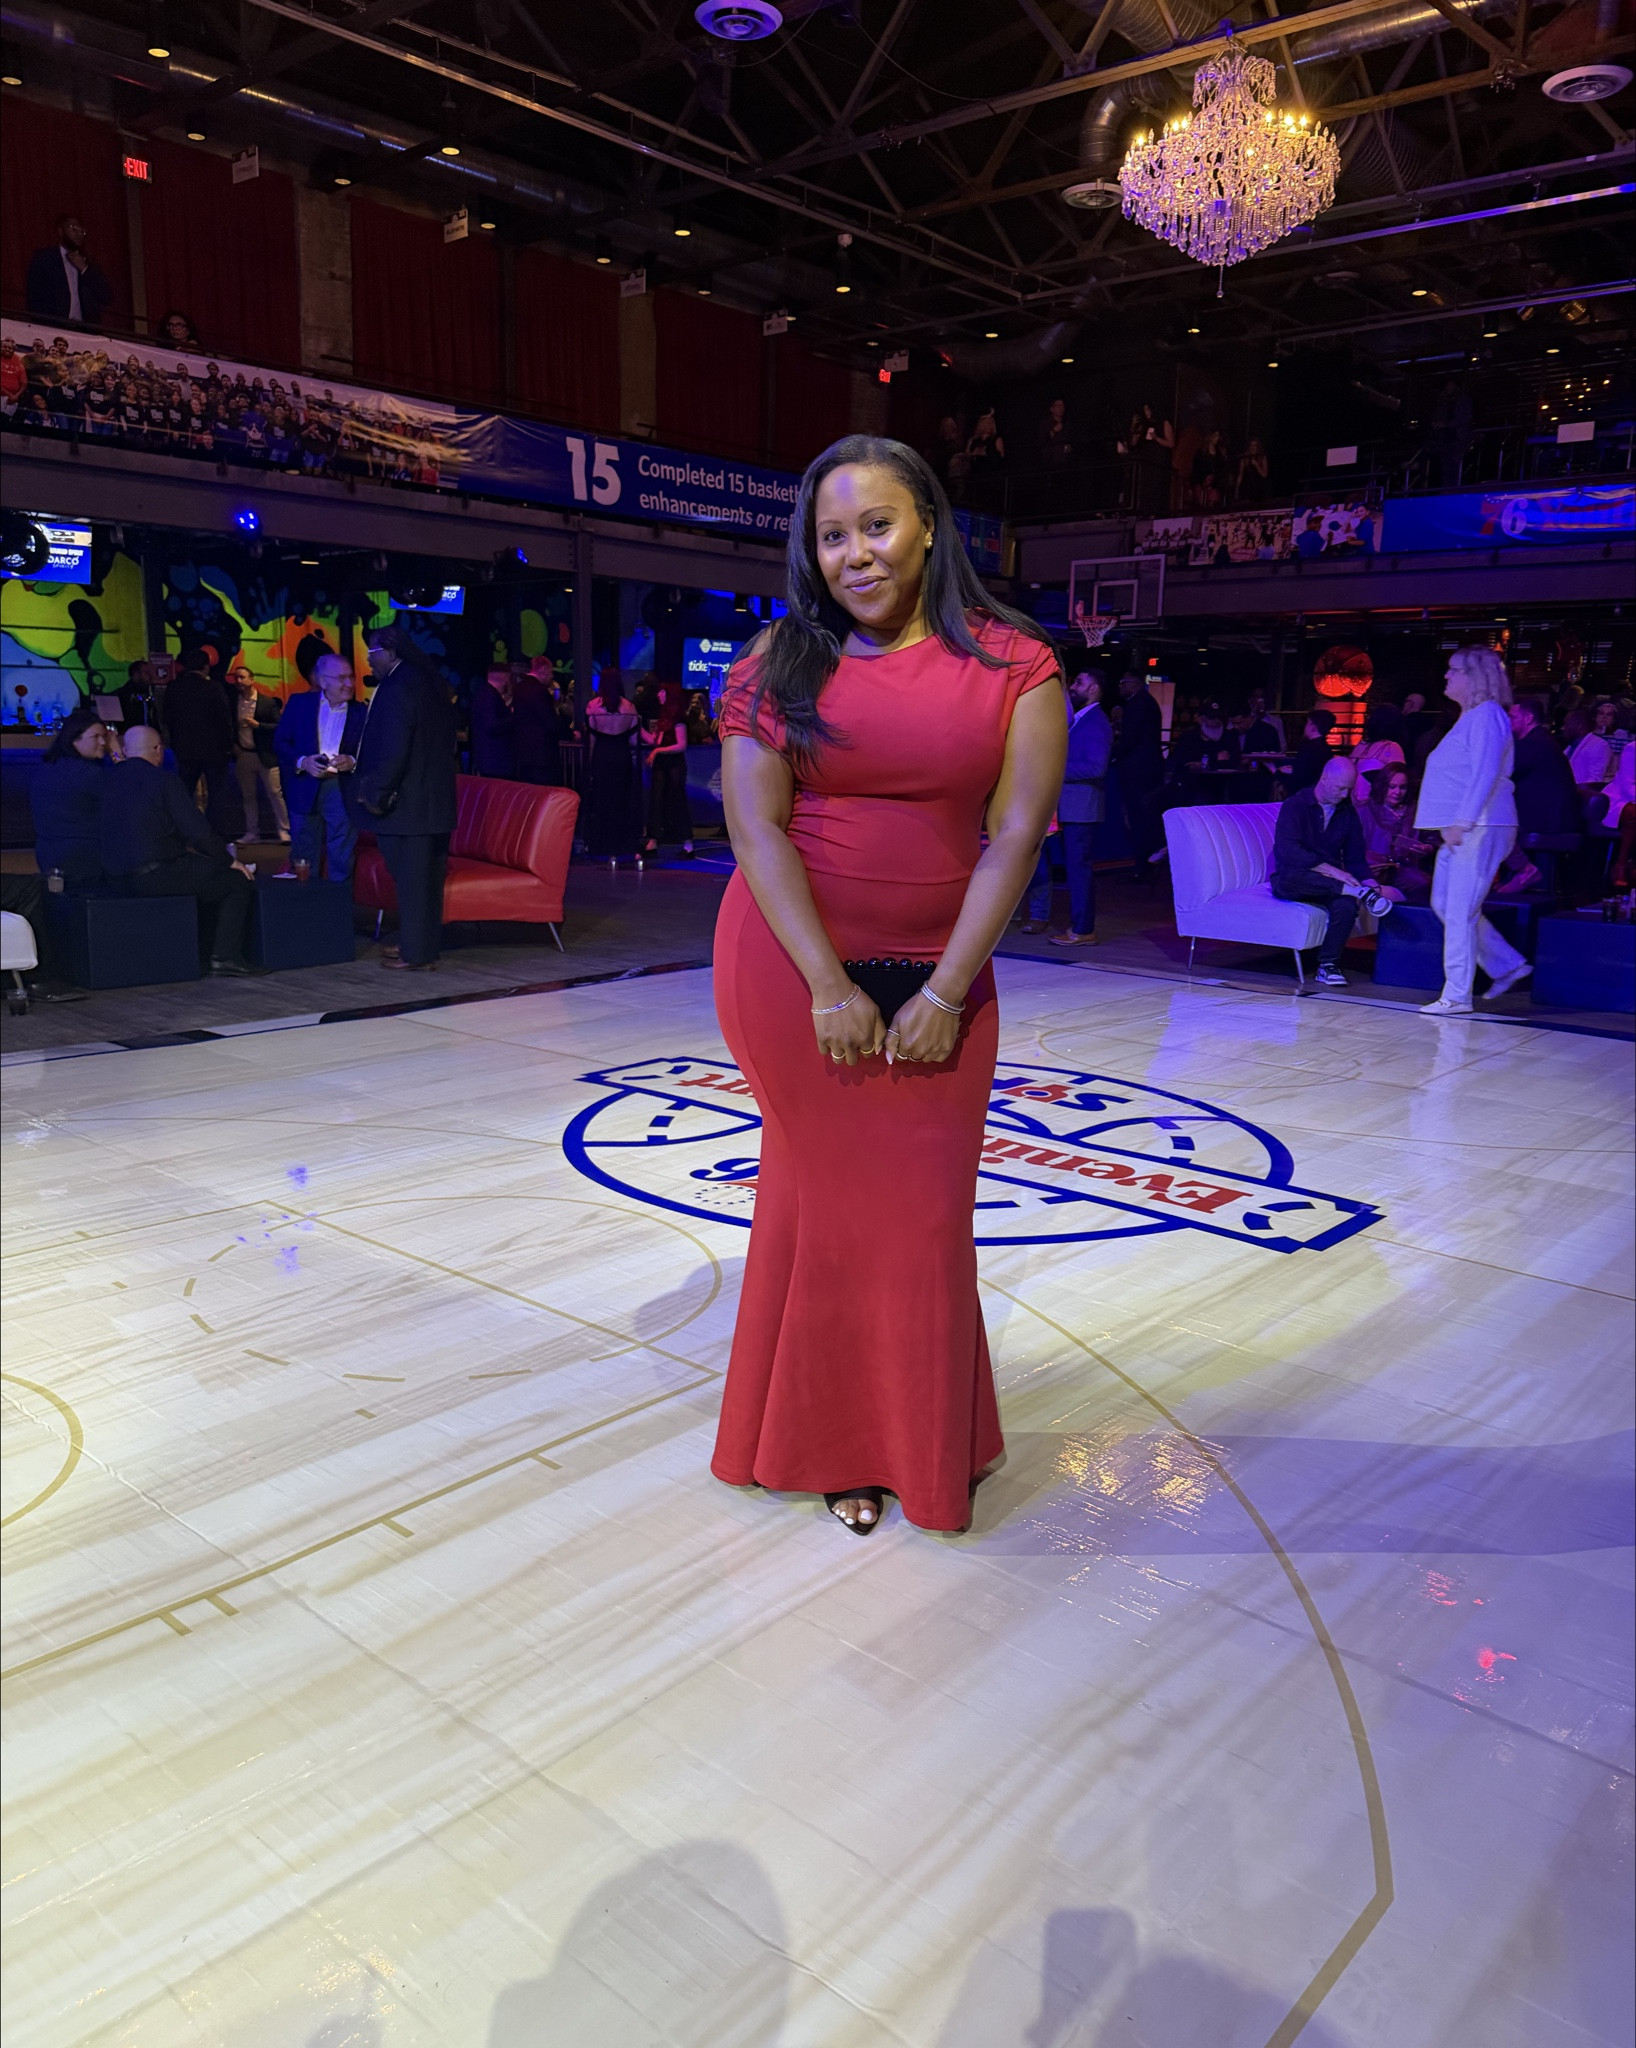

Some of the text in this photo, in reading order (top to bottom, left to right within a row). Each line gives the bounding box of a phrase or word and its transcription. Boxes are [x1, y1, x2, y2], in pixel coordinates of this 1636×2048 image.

[126, 157, 148, 179] EXIT
[566, 437, 621, 505] 15
[638, 455, 725, 490] Completed
[728, 472, 744, 493] 15
[640, 490, 753, 525] enhancements
[756, 513, 772, 528] or
[981, 1134, 1254, 1214] Eveni
